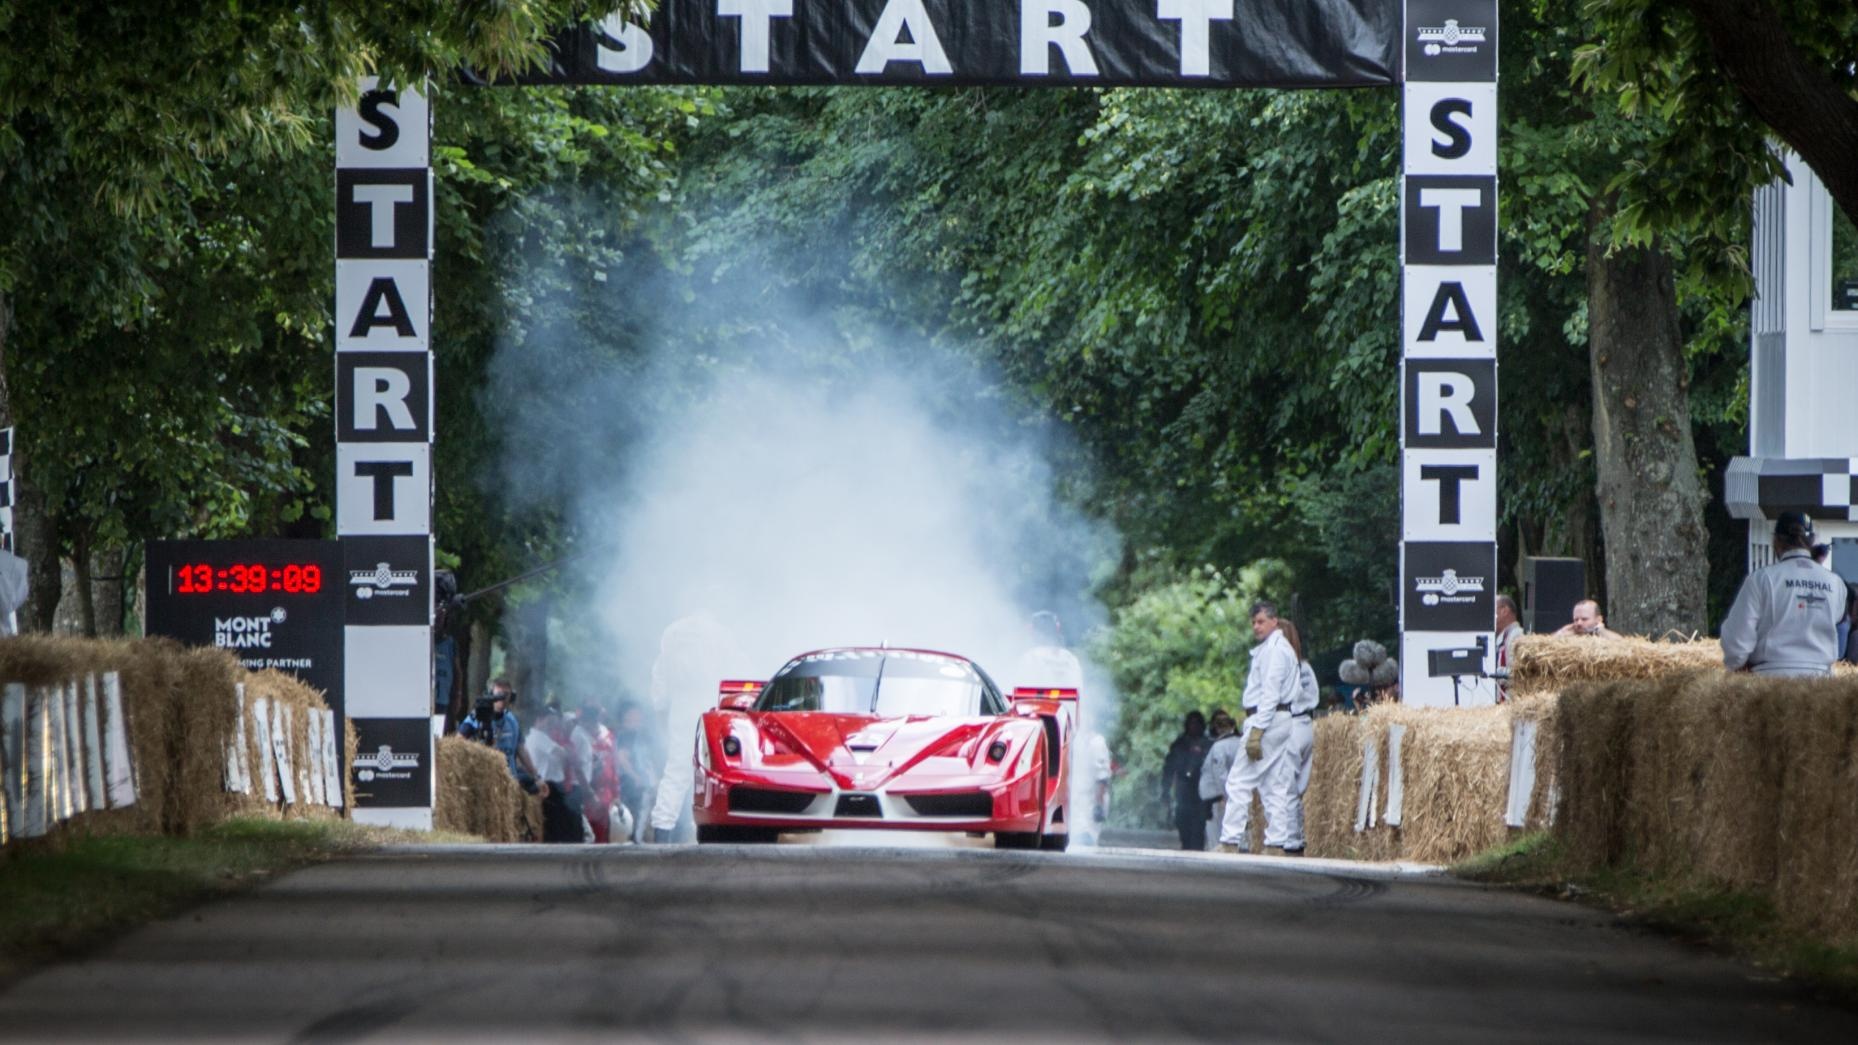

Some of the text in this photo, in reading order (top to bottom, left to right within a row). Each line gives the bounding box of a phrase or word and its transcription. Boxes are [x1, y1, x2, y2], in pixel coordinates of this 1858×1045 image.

[597, 0, 1234, 76] START
[348, 89, 416, 521] START
[1416, 97, 1484, 525] START
[178, 564, 321, 593] 13:39:09
[1785, 579, 1833, 592] MARSHAL
[215, 617, 271, 632] MONT
[215, 632, 271, 647] BLANC
[266, 658, 312, 668] PARTNER
